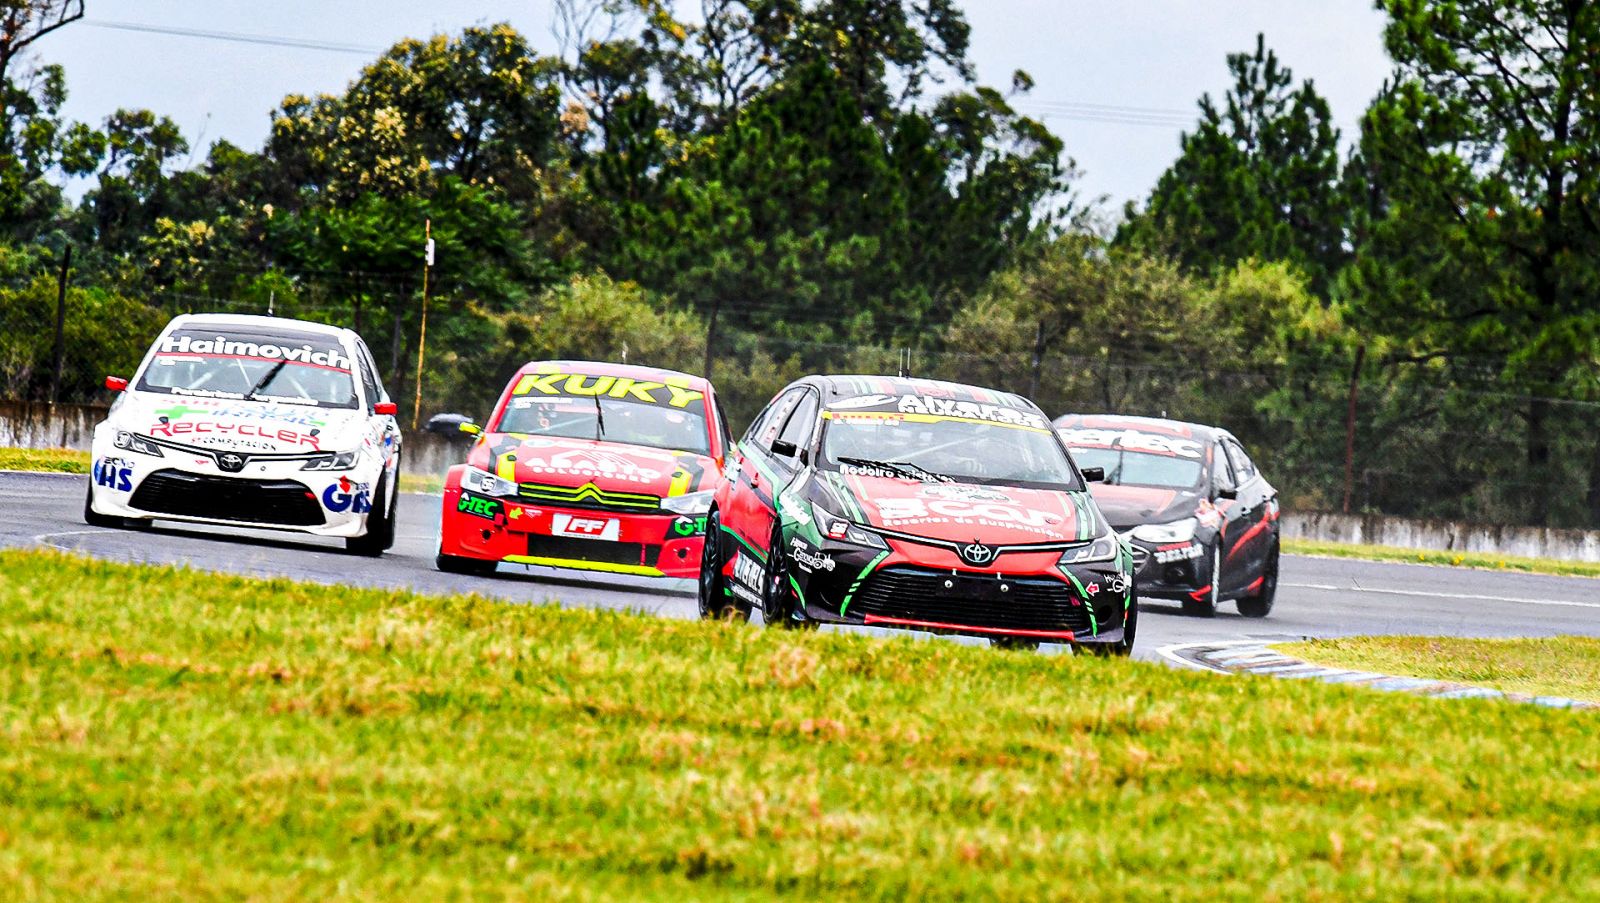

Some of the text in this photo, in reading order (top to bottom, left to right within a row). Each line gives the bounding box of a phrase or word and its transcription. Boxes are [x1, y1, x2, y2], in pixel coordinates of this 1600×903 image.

[161, 336, 350, 370] Haimovich
[512, 373, 704, 408] KUKY
[568, 518, 605, 533] FF
